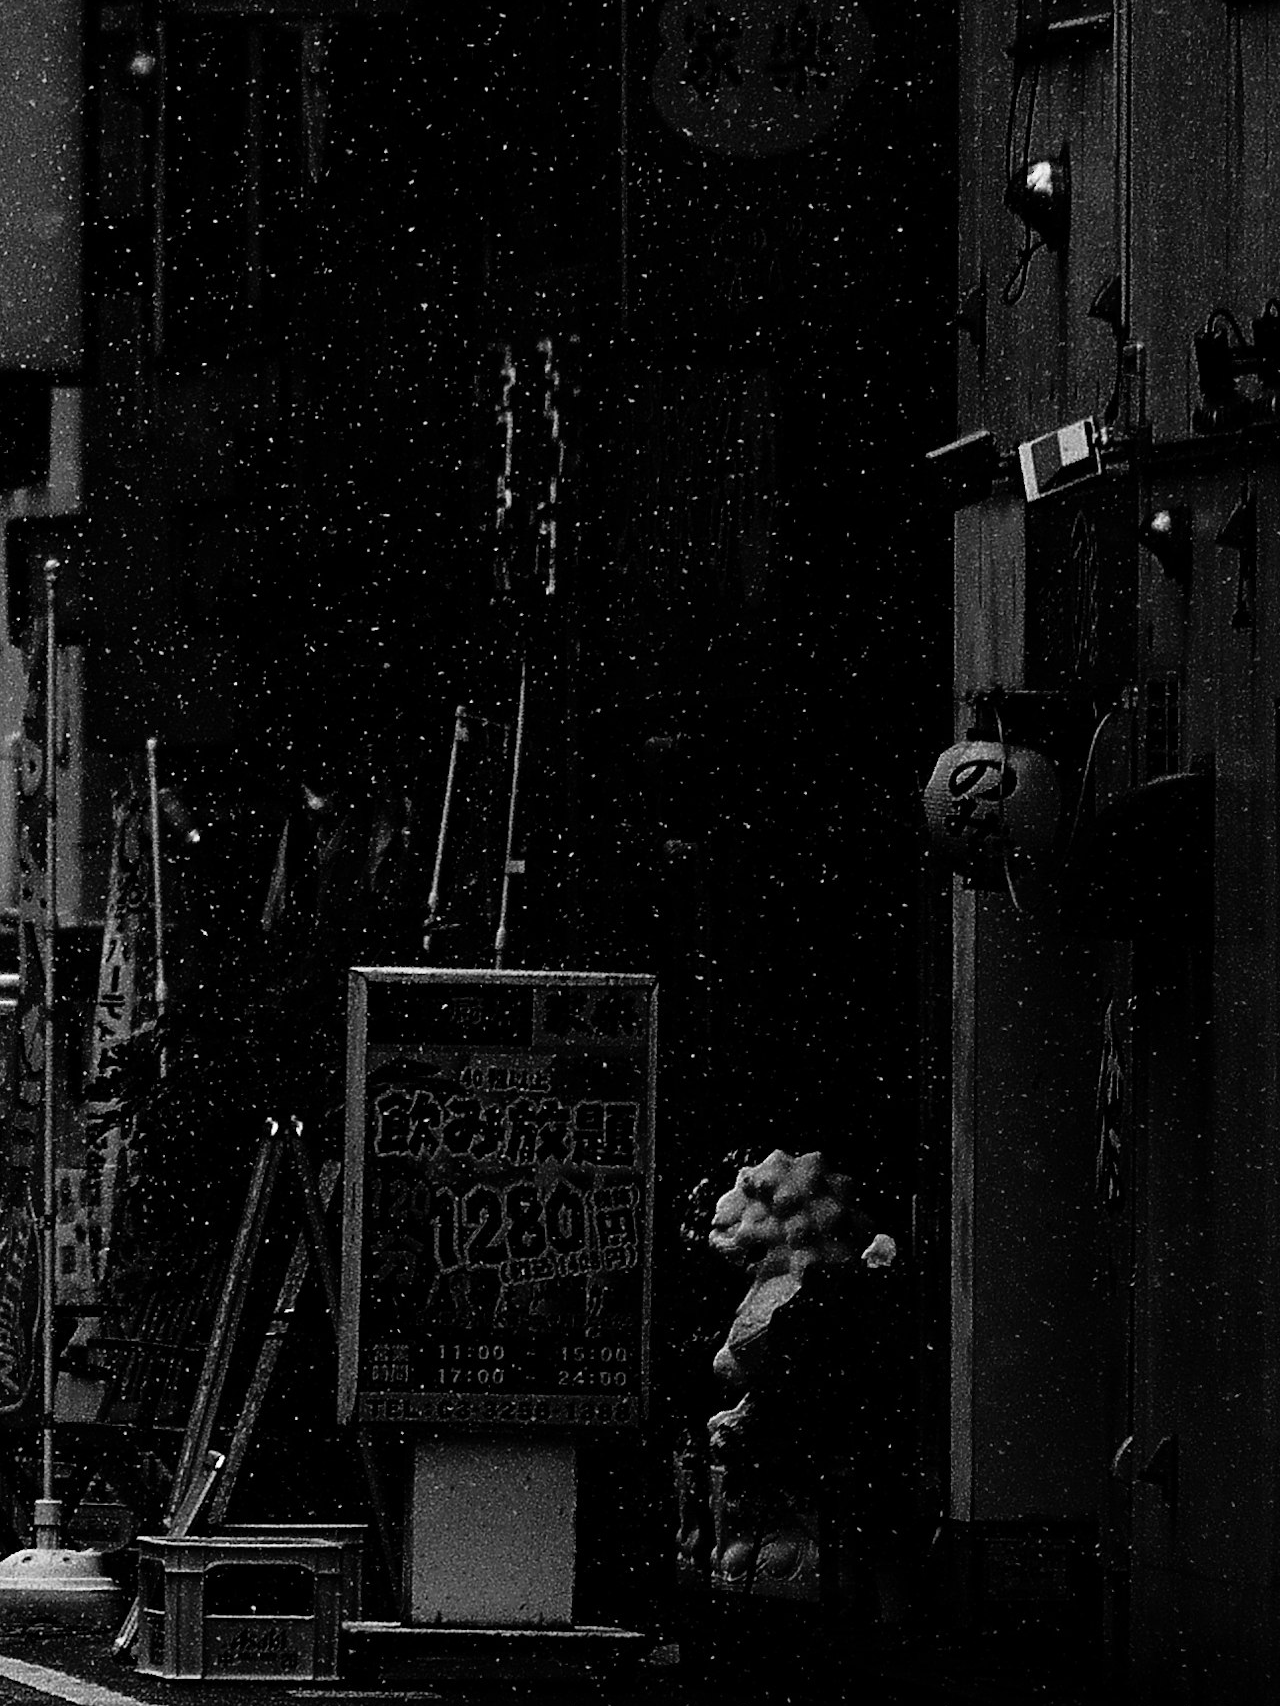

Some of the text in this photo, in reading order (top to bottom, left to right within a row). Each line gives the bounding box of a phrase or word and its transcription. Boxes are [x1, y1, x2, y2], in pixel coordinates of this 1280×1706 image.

[372, 1088, 640, 1168] 飲み放題
[438, 1345, 507, 1362] 11:00
[437, 1367, 506, 1385] 17:00
